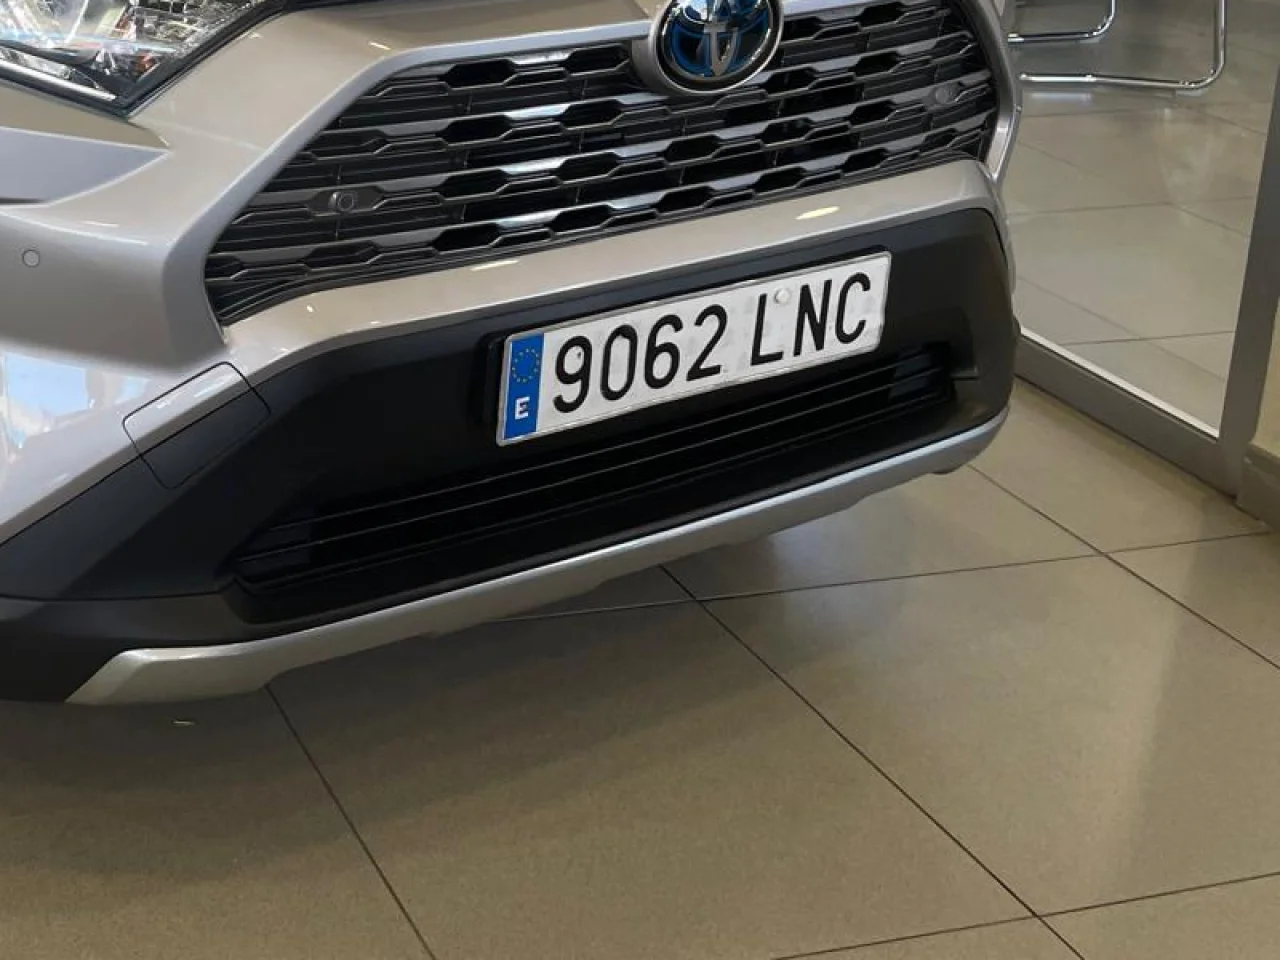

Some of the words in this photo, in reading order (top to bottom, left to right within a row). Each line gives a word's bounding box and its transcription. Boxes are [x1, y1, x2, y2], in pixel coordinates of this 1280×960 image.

[553, 303, 728, 413] 9062
[750, 271, 871, 367] LNC
[514, 396, 531, 419] E
